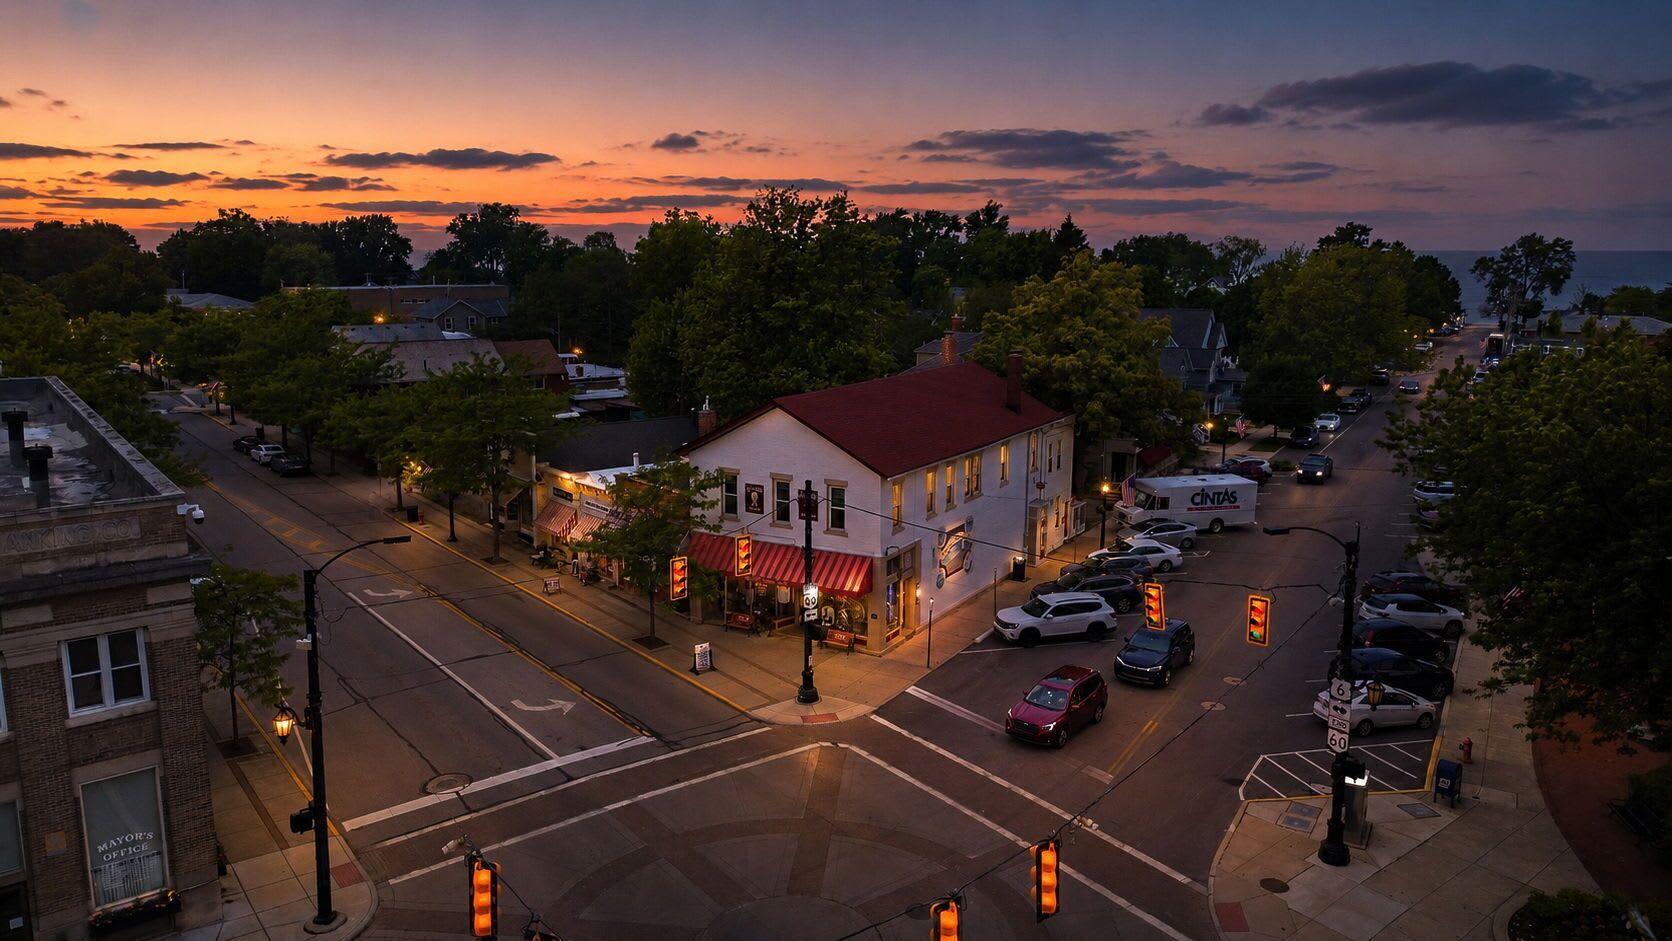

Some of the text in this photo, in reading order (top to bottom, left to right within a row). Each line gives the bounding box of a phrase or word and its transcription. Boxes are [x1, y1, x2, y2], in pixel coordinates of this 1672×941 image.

[1190, 488, 1238, 506] CINTAS
[1336, 683, 1345, 697] 6
[1330, 733, 1347, 750] 60
[97, 832, 154, 853] MAYOR'S
[103, 842, 150, 861] OFFICE
